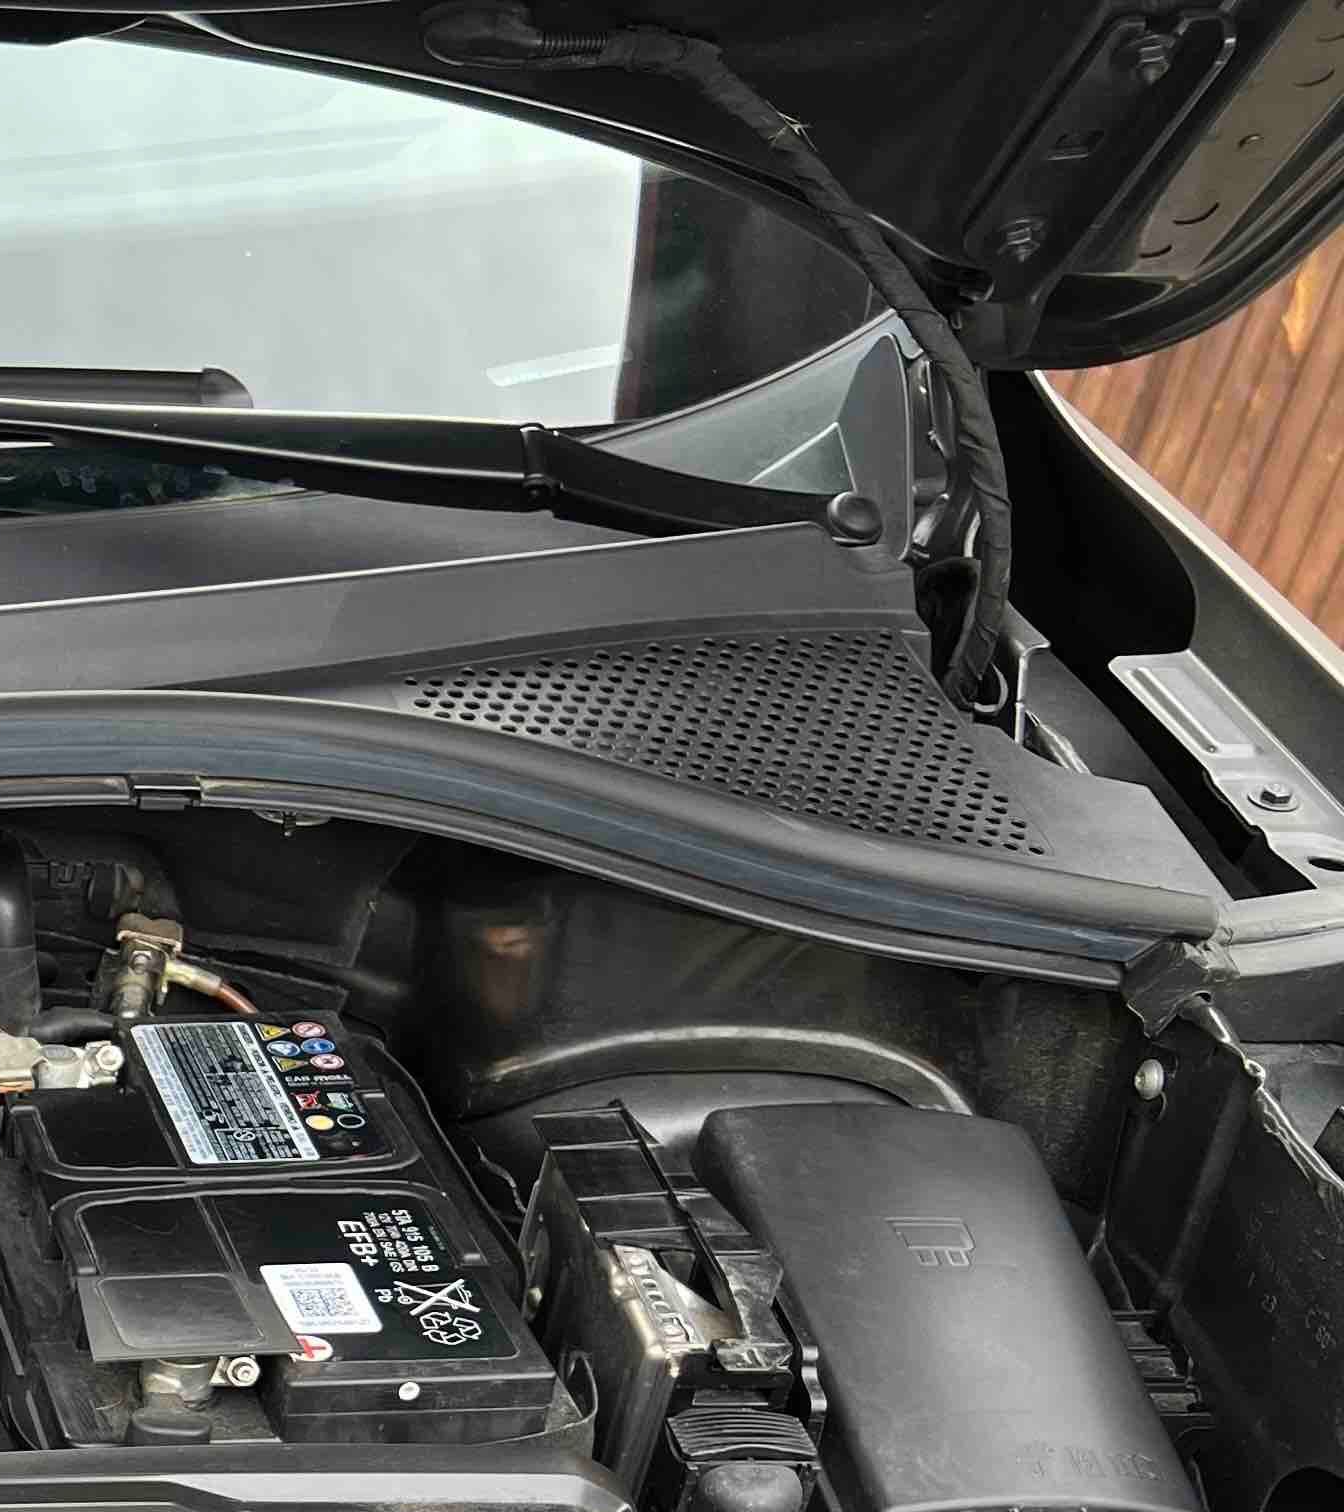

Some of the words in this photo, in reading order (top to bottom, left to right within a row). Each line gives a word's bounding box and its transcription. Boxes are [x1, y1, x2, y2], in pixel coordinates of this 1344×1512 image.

[337, 1220, 378, 1266] EFB+
[414, 1245, 434, 1262] 105
[374, 1288, 393, 1303] Pb
